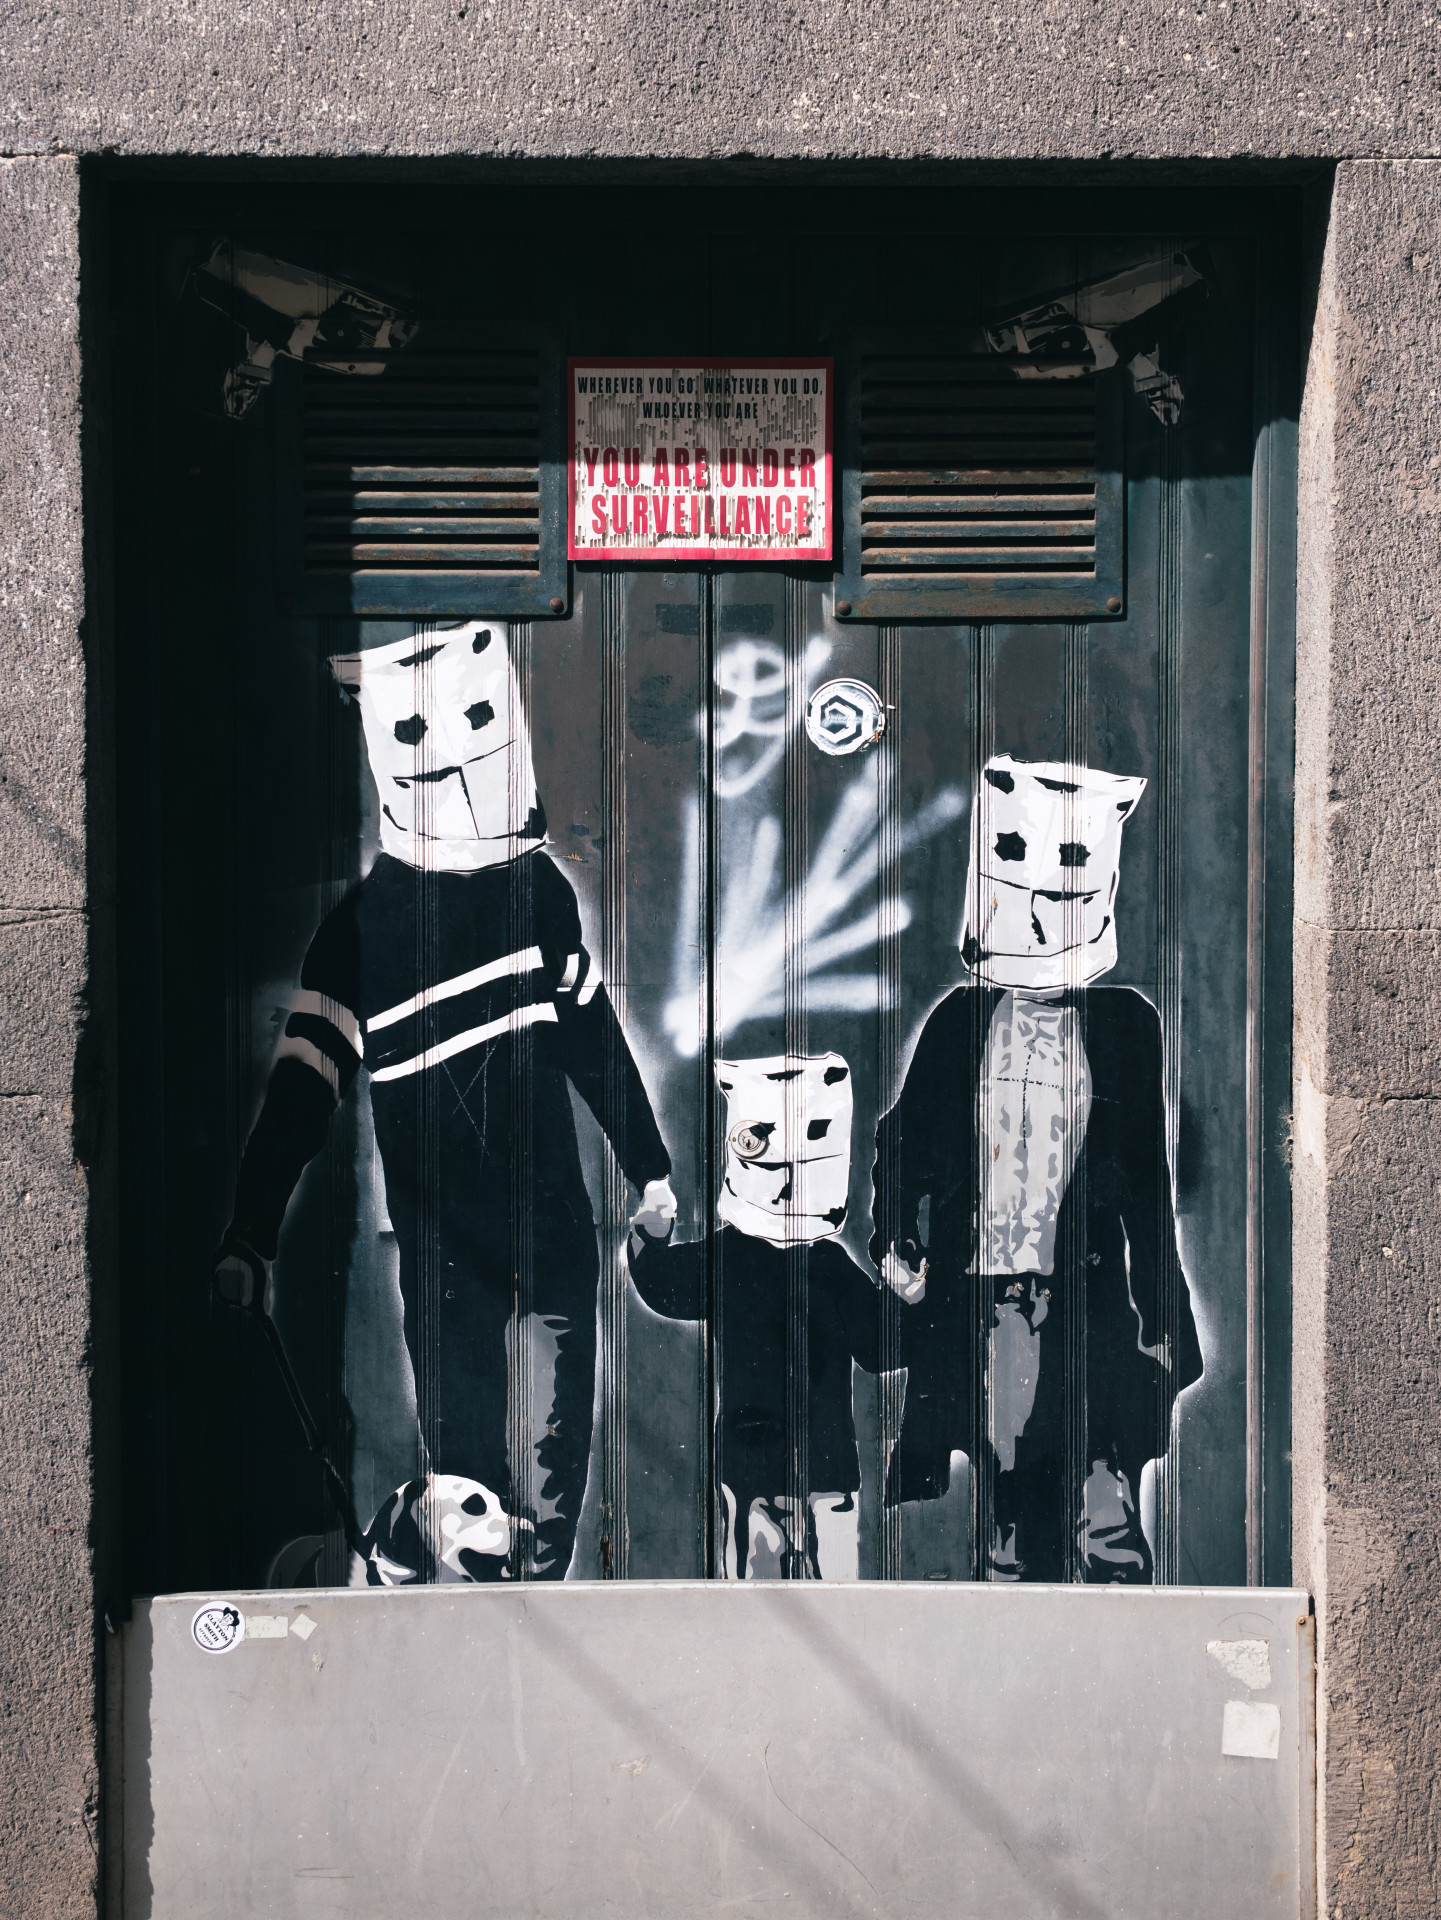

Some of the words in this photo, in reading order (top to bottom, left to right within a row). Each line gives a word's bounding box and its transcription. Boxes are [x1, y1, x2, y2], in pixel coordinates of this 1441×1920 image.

[578, 377, 643, 394] WHEREVER
[648, 377, 672, 394] YOU
[704, 377, 768, 394] WHATEVER
[774, 377, 797, 395] YOU
[803, 377, 823, 396] DO,
[643, 402, 701, 419] WHOEVER
[707, 402, 731, 419] YOU
[735, 402, 758, 419] ARE
[583, 447, 640, 487] YOU
[653, 447, 707, 487] ARE
[720, 447, 816, 488] UNDER
[591, 494, 810, 535] SURVEILLANCE
[204, 1623, 219, 1642] SMITH
[208, 1614, 228, 1641] CLAYTON
